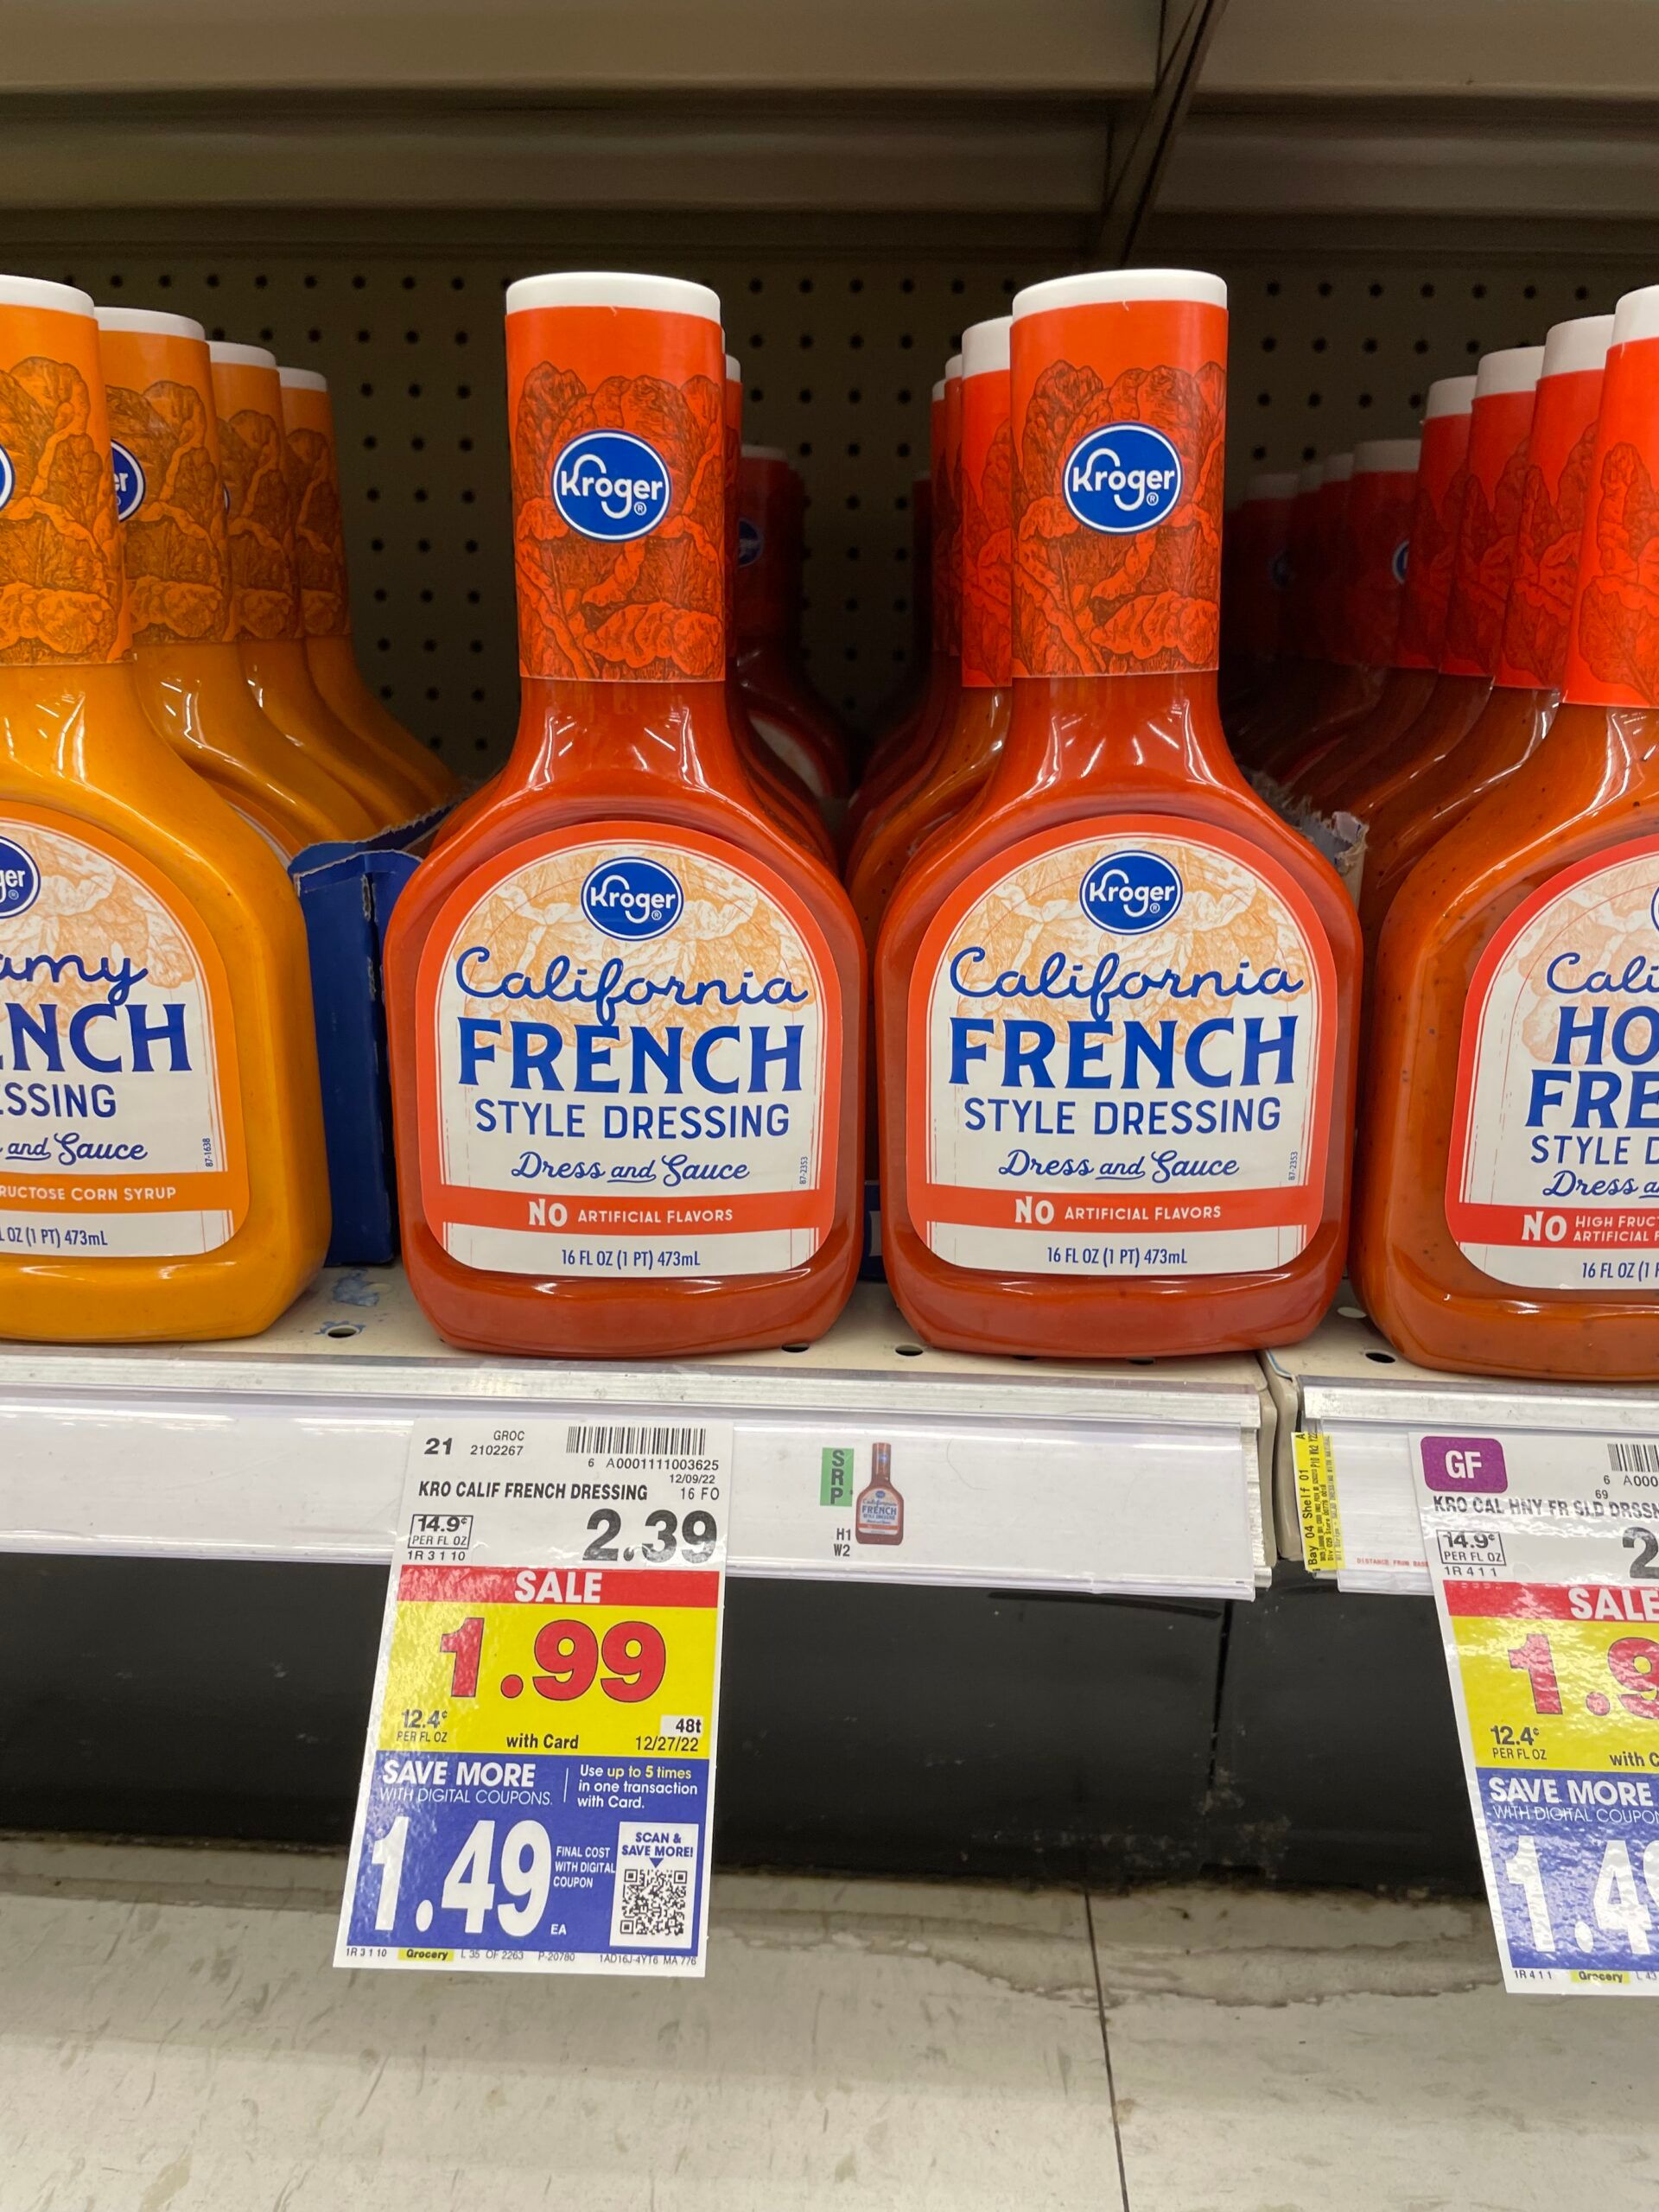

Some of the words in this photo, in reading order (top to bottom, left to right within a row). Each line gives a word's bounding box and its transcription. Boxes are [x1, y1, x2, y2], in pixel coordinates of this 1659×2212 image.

[561, 454, 663, 519] Kroger
[1073, 448, 1174, 511] Kroger
[589, 874, 676, 924] Kroger
[1089, 869, 1174, 917] Kroger
[456, 947, 809, 1026] California
[950, 946, 1304, 1021] California
[0, 1003, 192, 1073] NCH
[1552, 1006, 1659, 1065] HO
[457, 1017, 804, 1095] FRENCH
[949, 1015, 1298, 1089] FRENCH
[0, 1082, 116, 1117] SSING
[1525, 1070, 1659, 1128] FRE
[474, 1099, 586, 1138] STYLE
[604, 1103, 790, 1140] DRESSING
[965, 1097, 1076, 1135] STYLE
[1094, 1096, 1281, 1135] DRESSING
[8, 1138, 51, 1160] and
[54, 1132, 149, 1166] Sauce
[202, 1138, 213, 1166] 87-1638
[1530, 1135, 1630, 1165] STYLE
[512, 1151, 606, 1179] Dress
[608, 1161, 656, 1183] and
[661, 1154, 750, 1186] Sauce
[799, 1157, 809, 1185] 87-2353
[999, 1148, 1094, 1176] Dress
[1096, 1158, 1145, 1179] and
[1151, 1150, 1239, 1183] Sauce
[1288, 1151, 1298, 1180] 87-2353
[1542, 1170, 1638, 1197] Dress
[71, 1187, 118, 1200] CORN
[124, 1187, 176, 1200] SYRUP
[529, 1199, 569, 1227] NO
[578, 1210, 661, 1224] ARTIFICIAL
[667, 1209, 733, 1224] FLAVORS
[1015, 1196, 1055, 1225] NO
[1065, 1206, 1149, 1221] ARTIFICIAL
[1155, 1205, 1221, 1221] FLAVORS
[1522, 1211, 1567, 1242] NO
[1575, 1216, 1613, 1228] HIGH
[7, 1227, 21, 1243] OZ
[41, 1228, 60, 1248] PT)
[65, 1230, 107, 1246] 473mL
[1573, 1230, 1649, 1242] ARTIFICIAL
[563, 1250, 575, 1265] 16
[579, 1251, 594, 1267] FL
[597, 1251, 613, 1267] OZ
[617, 1250, 629, 1269] (1
[633, 1251, 653, 1269] PT)
[658, 1251, 701, 1266] 473mL
[1047, 1248, 1061, 1262] 16
[1065, 1248, 1079, 1263] FL
[1083, 1248, 1100, 1264] OZ
[1103, 1247, 1115, 1268] (1
[1119, 1247, 1140, 1268] PT)
[1144, 1248, 1188, 1265] 473mL
[1582, 1263, 1596, 1278] 16
[1600, 1263, 1613, 1278] FL
[1618, 1263, 1635, 1278] OZ
[493, 1431, 524, 1441] GROC
[424, 1438, 454, 1455] 21
[470, 1445, 524, 1456] 2102267
[588, 1459, 594, 1468] 6
[607, 1459, 719, 1471] A0001111003625
[1446, 1450, 1482, 1479] GF
[670, 1474, 715, 1484] 12/09/22
[1300, 1470, 1308, 1480] 01
[419, 1481, 452, 1497] KRO
[455, 1482, 500, 1497] CALIF
[504, 1484, 566, 1499] FRENCH
[570, 1484, 648, 1500] DRESSING
[681, 1488, 695, 1499] 16
[701, 1487, 720, 1500] FO
[1595, 1490, 1608, 1499] 69
[1300, 1488, 1313, 1519] Shelf
[1433, 1496, 1467, 1512] KRO
[1473, 1497, 1504, 1514] CAL
[1510, 1498, 1541, 1516] HNY
[1549, 1500, 1569, 1516] FR
[1573, 1501, 1605, 1516] SLD
[412, 1535, 434, 1545] PER
[437, 1535, 449, 1545] FL
[453, 1536, 467, 1546] OZ
[582, 1509, 717, 1563] 2.39
[836, 1528, 850, 1541] H1
[1306, 1525, 1315, 1538] 04
[834, 1544, 850, 1556] W2
[1308, 1545, 1319, 1565] Bay
[1445, 1552, 1466, 1560] PER
[1471, 1552, 1484, 1561] FL
[1488, 1553, 1503, 1562] OZ
[515, 1571, 602, 1604] SALE
[1568, 1588, 1659, 1621] SALE
[440, 1617, 666, 1702] 1.99
[676, 1719, 702, 1733] 48t
[397, 1731, 417, 1741] PER
[421, 1731, 431, 1742] FL
[434, 1732, 448, 1742] OZ
[506, 1734, 539, 1748] with
[543, 1735, 579, 1750] Card
[635, 1737, 698, 1752] 12/27/22
[1492, 1748, 1514, 1759] PER
[1517, 1749, 1529, 1759] FL
[1532, 1749, 1547, 1761] OZ
[1609, 1751, 1645, 1766] with
[383, 1760, 449, 1786] SAVE
[455, 1762, 536, 1787] MORE
[580, 1765, 604, 1777] Use
[607, 1767, 625, 1782] up
[628, 1766, 641, 1778] to
[645, 1766, 653, 1778] 5
[657, 1767, 691, 1779] times
[378, 1788, 413, 1802] WITH
[417, 1789, 471, 1803] DIGITAL
[475, 1790, 553, 1805] COUPONS.
[578, 1781, 587, 1792] in
[590, 1783, 620, 1794] one
[623, 1782, 698, 1796] transaction
[1489, 1777, 1560, 1803] SAVE
[1567, 1780, 1654, 1807] MORE
[577, 1796, 604, 1808] with
[607, 1796, 645, 1809] Card.
[1493, 1806, 1531, 1820] WITH
[1533, 1807, 1592, 1822] DIGITAL
[635, 1833, 670, 1843] SCAN
[673, 1834, 682, 1844] &
[556, 1847, 582, 1858] FINAL
[585, 1847, 610, 1859] COST
[621, 1846, 655, 1857] SAVE
[658, 1847, 693, 1858] MORE!
[371, 1816, 553, 1937] 1.49
[555, 1862, 577, 1872] WITH
[580, 1862, 615, 1874] DIGITAL
[553, 1876, 594, 1888] COUPON
[551, 1923, 567, 1935] EA
[406, 1949, 448, 1960] Grocery
[502, 1951, 524, 1960] 2263
[1579, 1971, 1623, 1983] Grocery
